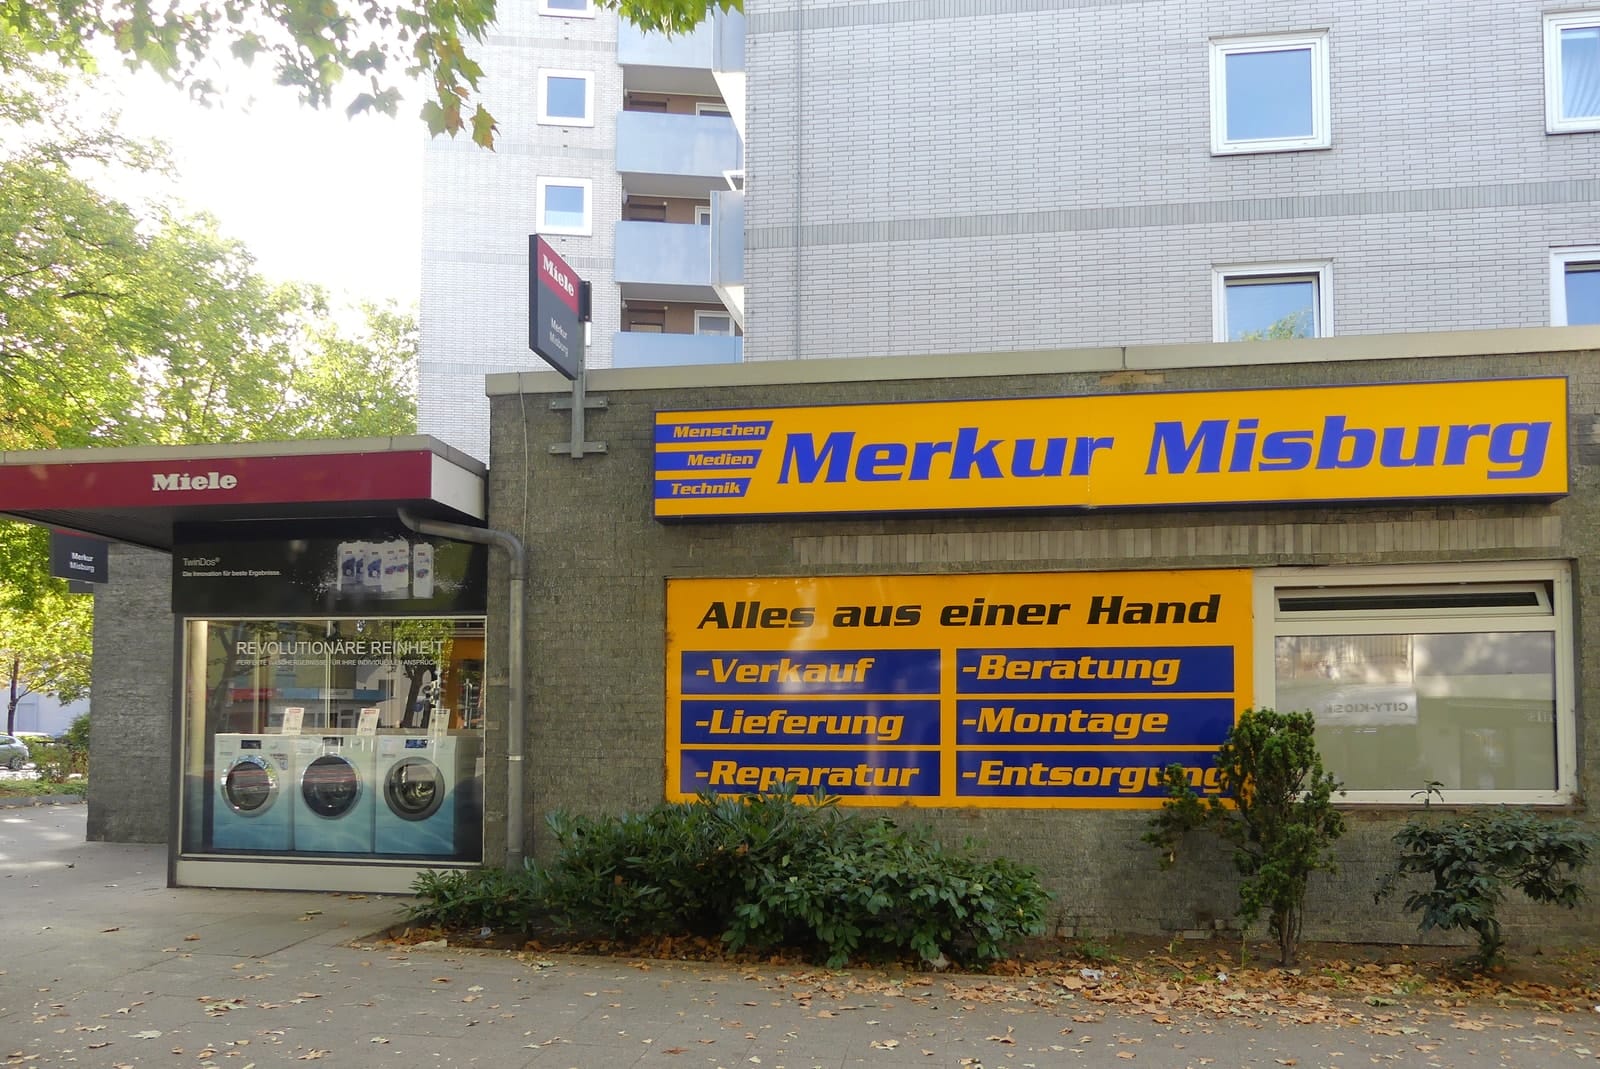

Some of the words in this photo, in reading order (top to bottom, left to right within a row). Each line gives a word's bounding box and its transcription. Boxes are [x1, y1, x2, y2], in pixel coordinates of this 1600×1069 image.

[543, 254, 575, 296] Miele
[551, 317, 568, 339] Merkur
[549, 331, 568, 358] Misburg
[673, 423, 766, 439] Menschen
[687, 452, 753, 467] Medien
[777, 427, 1114, 484] Merkur
[1144, 415, 1552, 480] Misburg
[152, 472, 238, 491] Miele
[671, 481, 742, 496] Technik
[69, 561, 95, 574] Misburg
[71, 552, 94, 562] Merkur
[697, 599, 815, 630] Alles
[832, 604, 921, 628] aus
[939, 597, 1071, 627] einer
[1087, 593, 1221, 625] Hand
[236, 639, 368, 655] REVOLUTIONÄRE
[371, 641, 444, 655] REINHEIT
[695, 657, 875, 684] -Verkauf
[962, 654, 1181, 685] -Beratung
[695, 708, 904, 740] -Lieferung
[962, 706, 1169, 739] -Montage
[695, 760, 920, 791] -Reparatur
